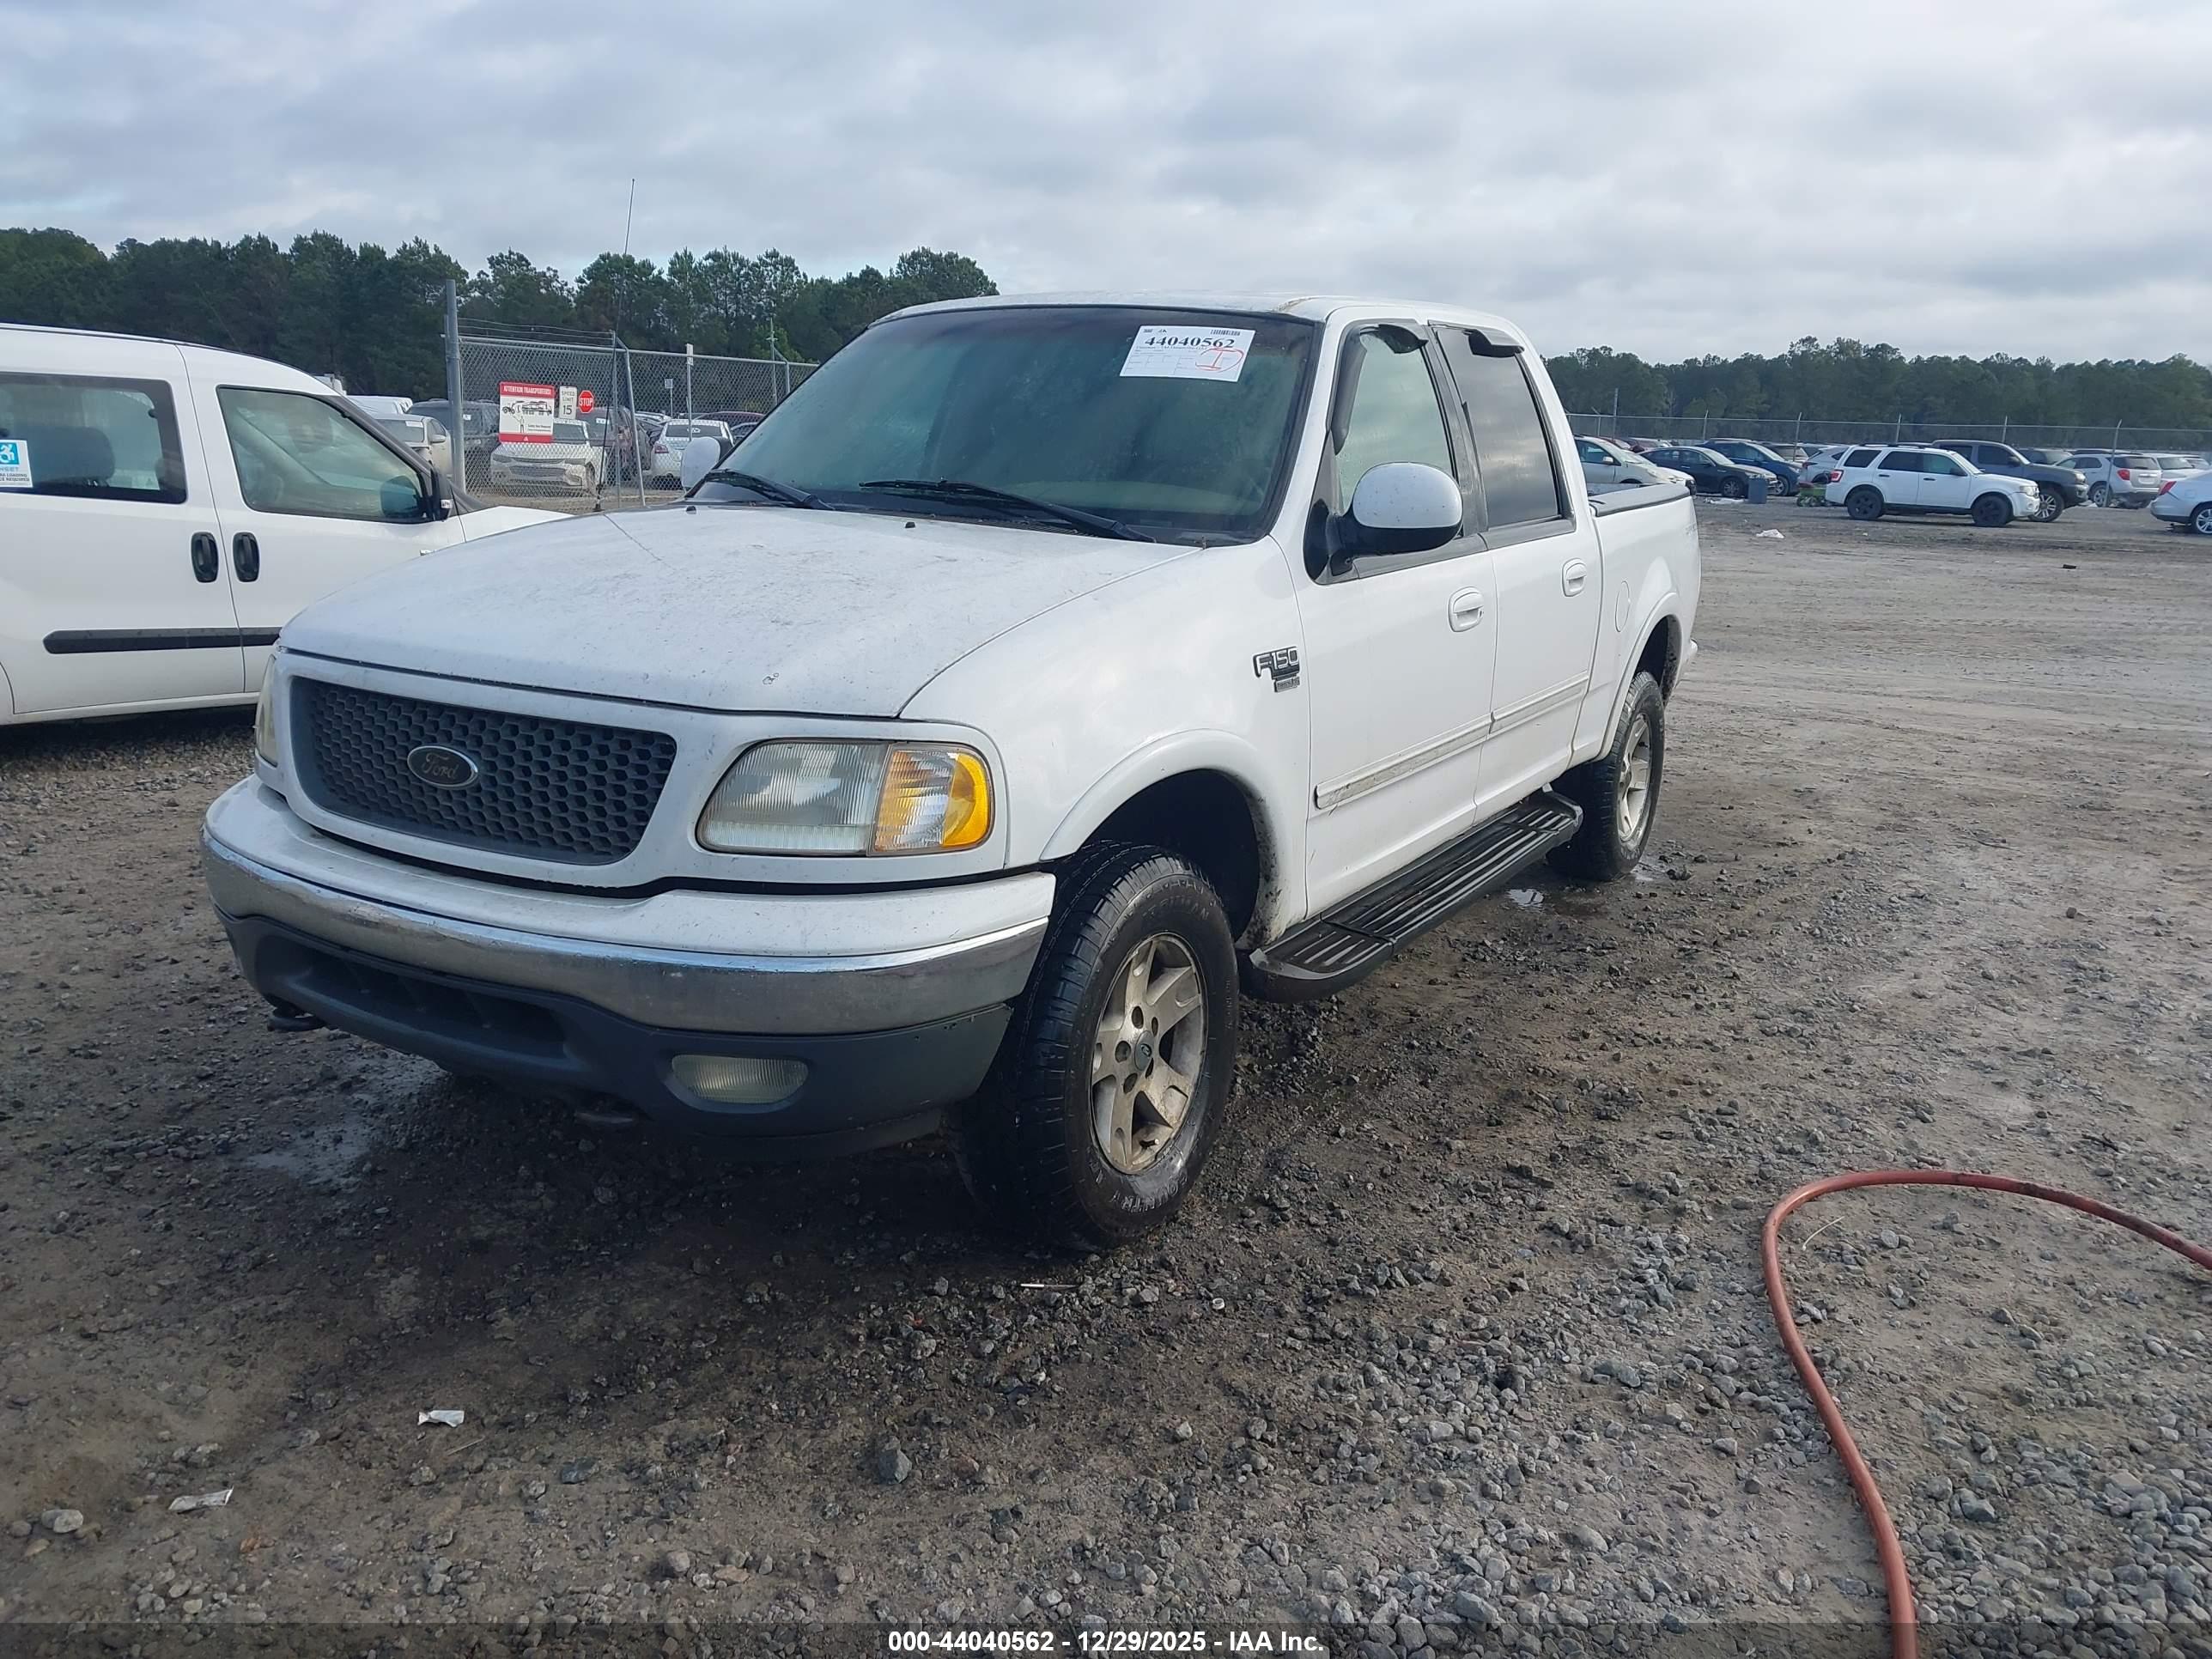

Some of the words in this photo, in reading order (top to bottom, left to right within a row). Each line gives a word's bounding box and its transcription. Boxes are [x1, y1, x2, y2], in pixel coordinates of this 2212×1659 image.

[1145, 336, 1235, 348] 44040562
[579, 398, 593, 406] STOP
[562, 404, 573, 415] 15
[422, 752, 459, 780] Ford
